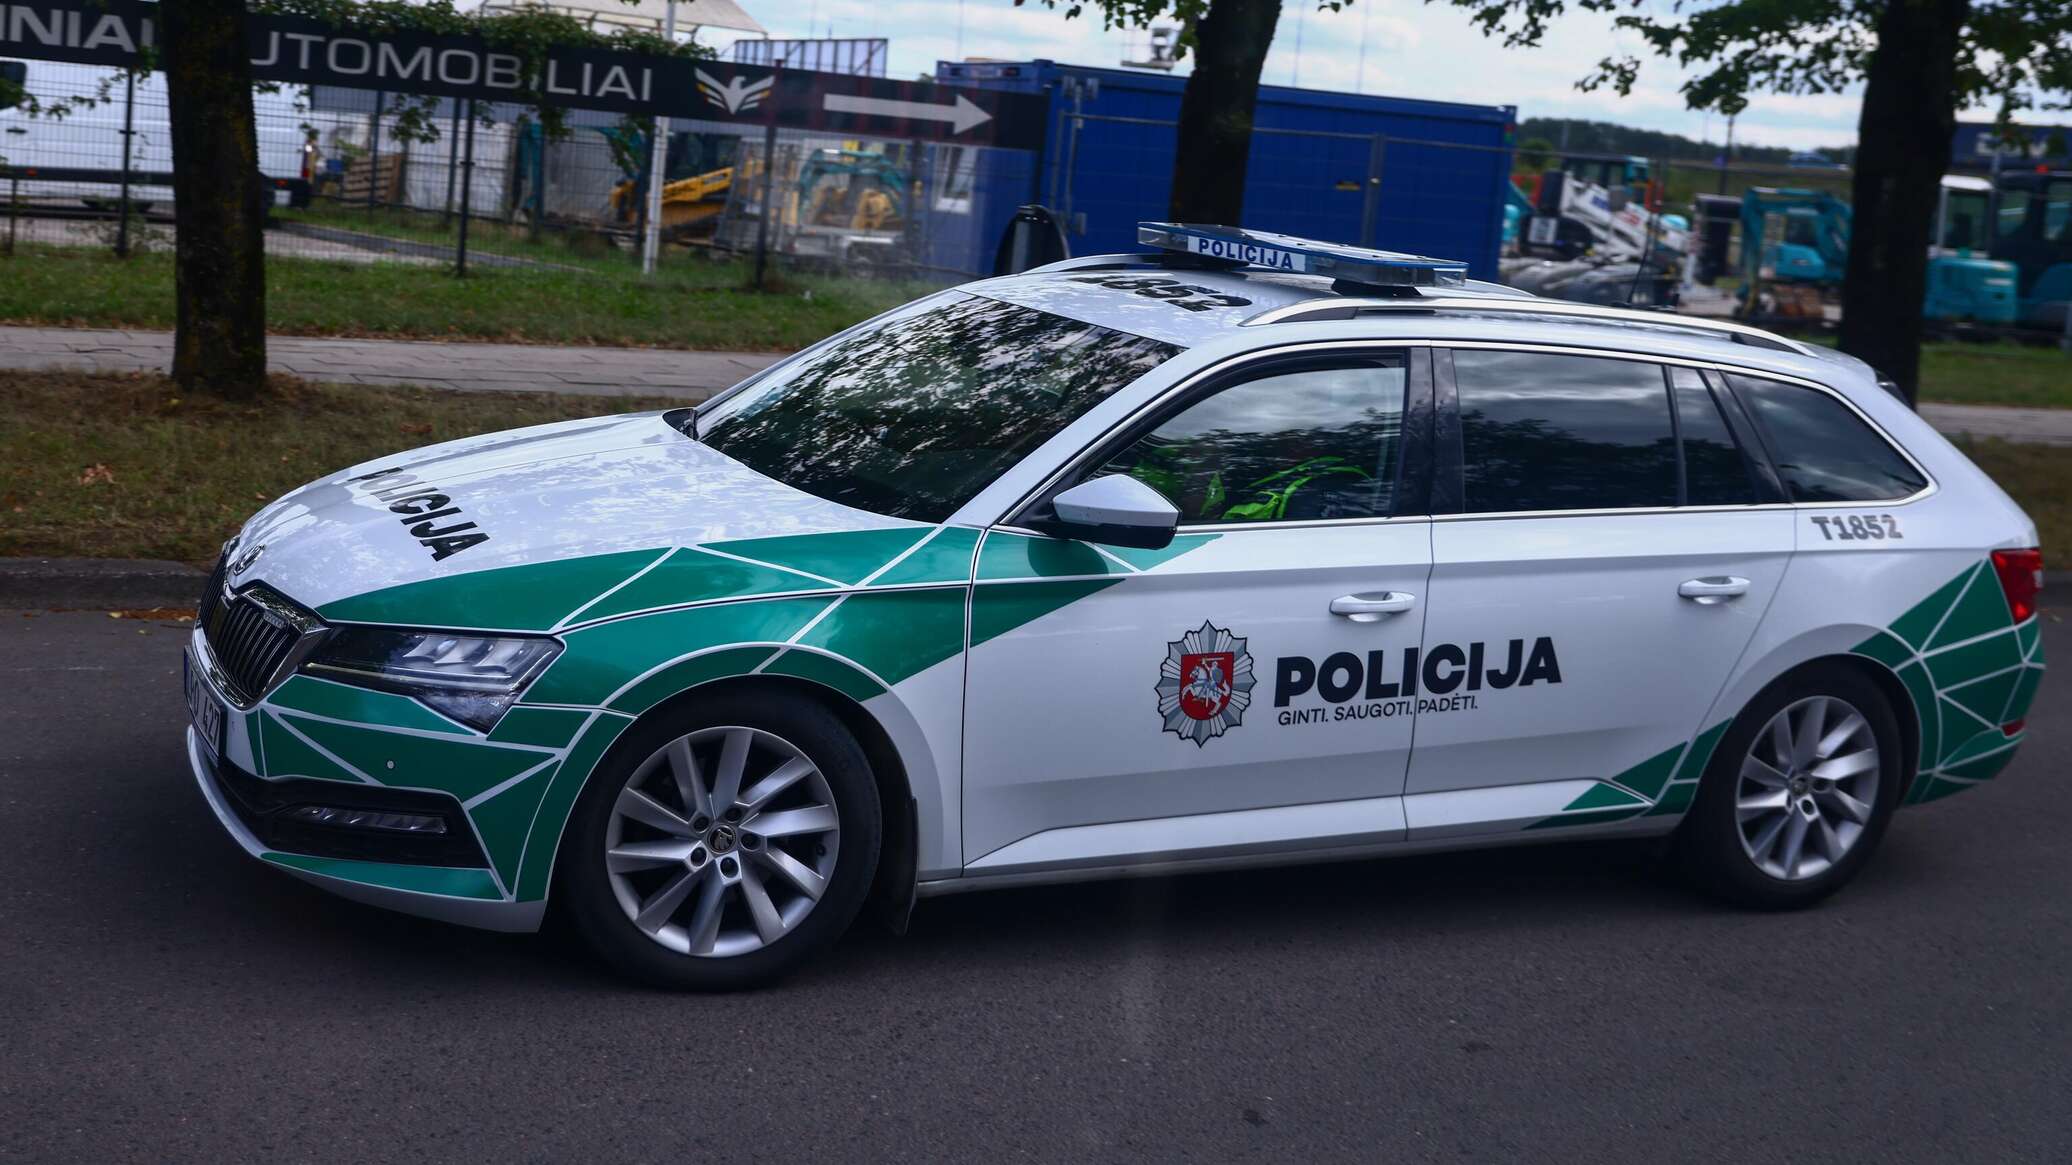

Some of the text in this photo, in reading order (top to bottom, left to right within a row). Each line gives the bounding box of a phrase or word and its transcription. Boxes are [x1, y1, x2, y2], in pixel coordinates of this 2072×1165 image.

[1198, 238, 1293, 270] POLICIJA
[347, 466, 490, 562] POLICIJA
[1810, 513, 1904, 541] T1852
[1273, 636, 1563, 708] POLICIJA
[1277, 692, 1479, 727] GINTI. SAUGOTI. PADĖTI.
